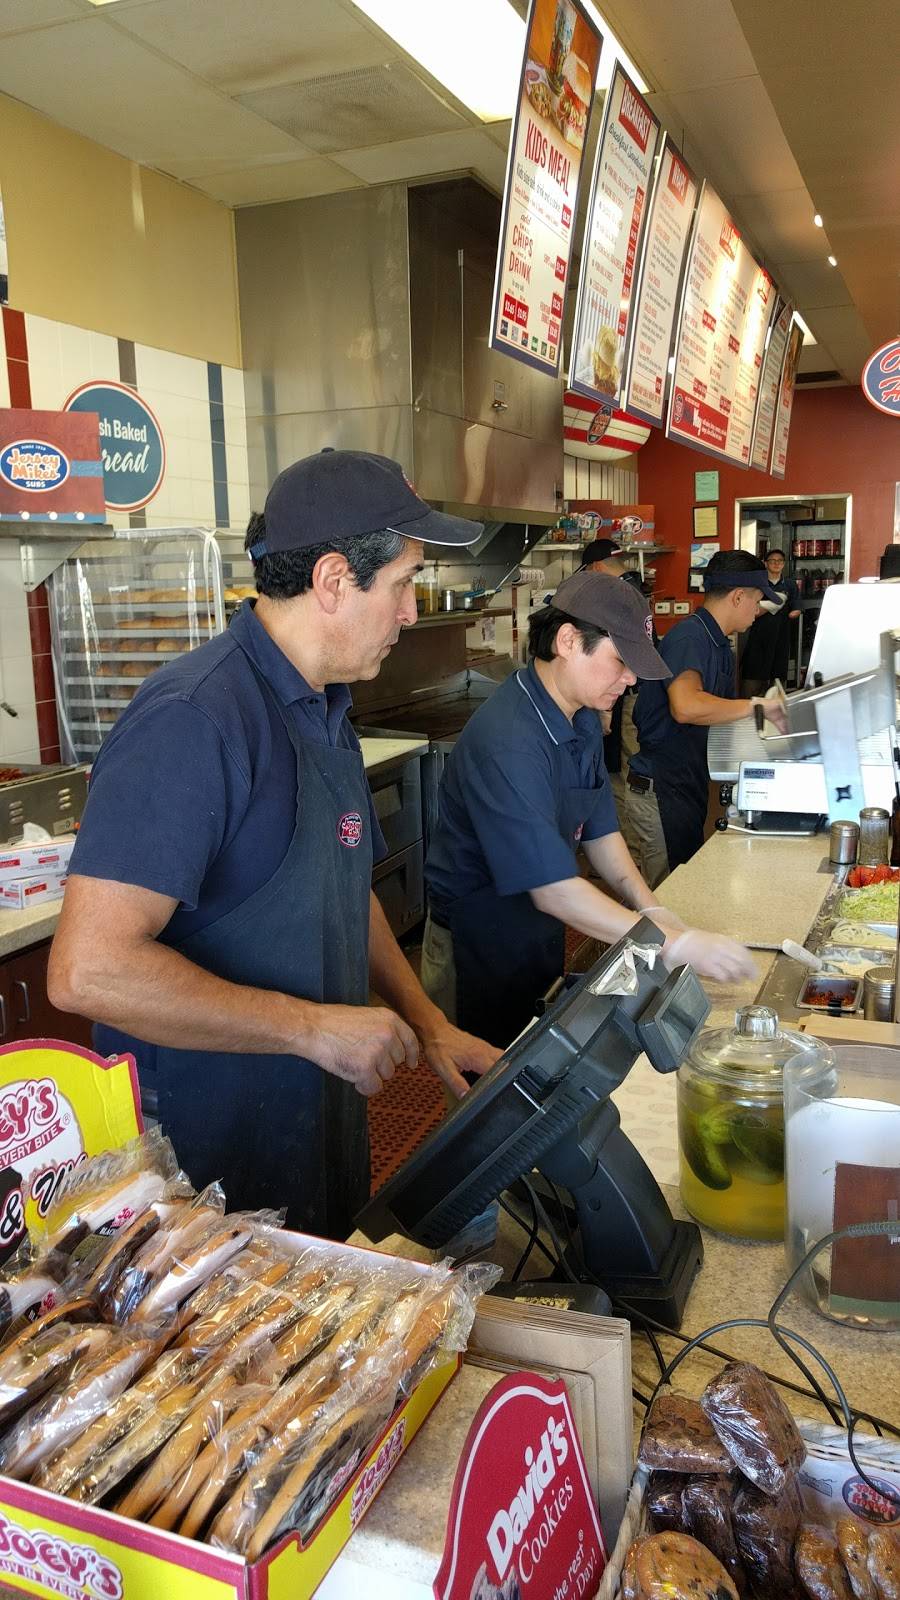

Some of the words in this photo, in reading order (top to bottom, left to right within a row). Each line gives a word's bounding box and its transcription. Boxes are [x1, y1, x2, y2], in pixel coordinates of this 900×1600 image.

[525, 118, 548, 169] KIDS
[548, 144, 571, 197] MEAL
[512, 225, 534, 258] CHIPS
[509, 251, 532, 285] DRINK
[113, 419, 147, 443] Baked
[8, 448, 60, 470] Jersey
[101, 444, 150, 473] read
[34, 1124, 59, 1150] BITE
[1, 1193, 21, 1239] &
[486, 1416, 569, 1580] David's
[519, 1476, 573, 1583] Cookies
[568, 1543, 584, 1582] rest
[576, 1547, 597, 1599] Day!
